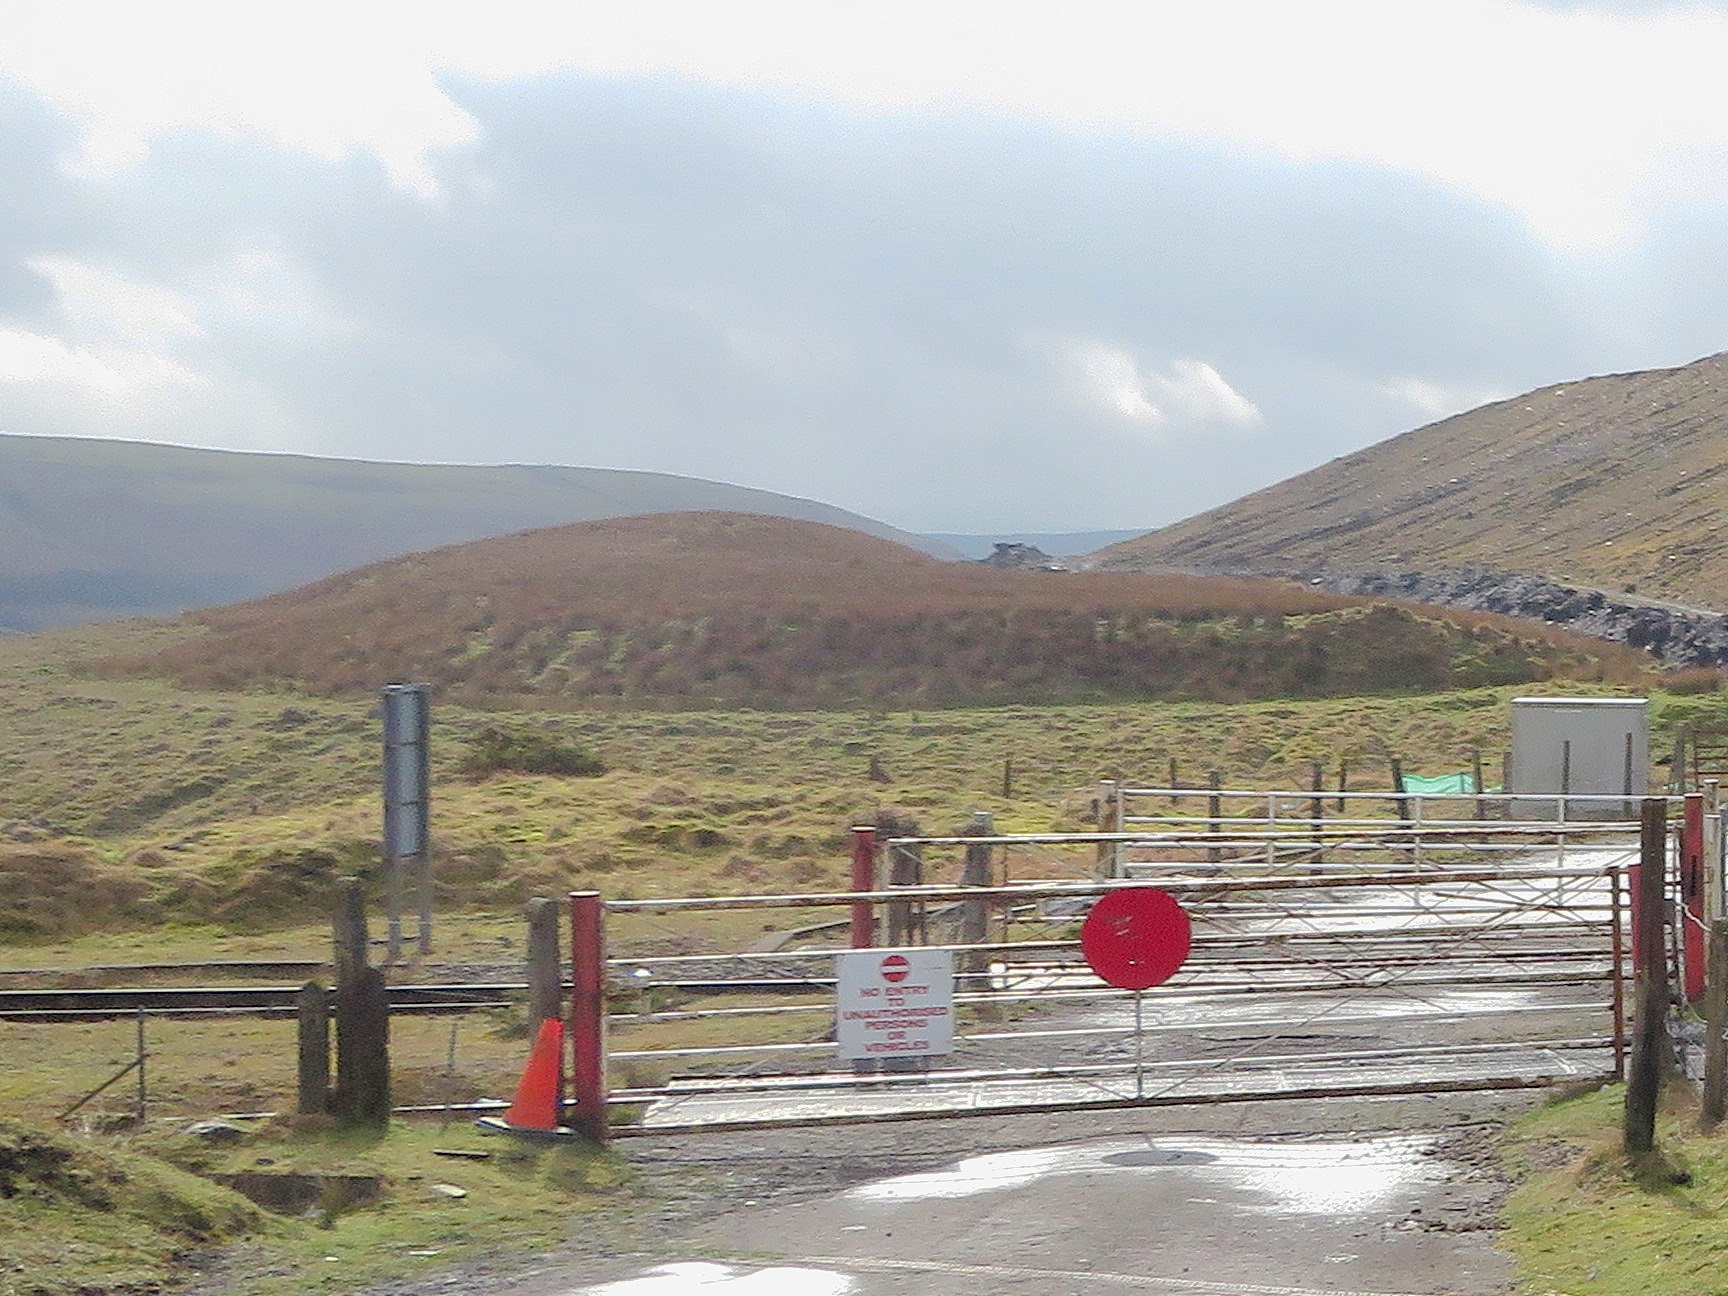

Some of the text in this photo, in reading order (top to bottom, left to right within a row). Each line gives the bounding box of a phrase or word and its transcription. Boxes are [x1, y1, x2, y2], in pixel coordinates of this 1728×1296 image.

[859, 985, 928, 997] NO ENTRY
[888, 998, 905, 1007] TO
